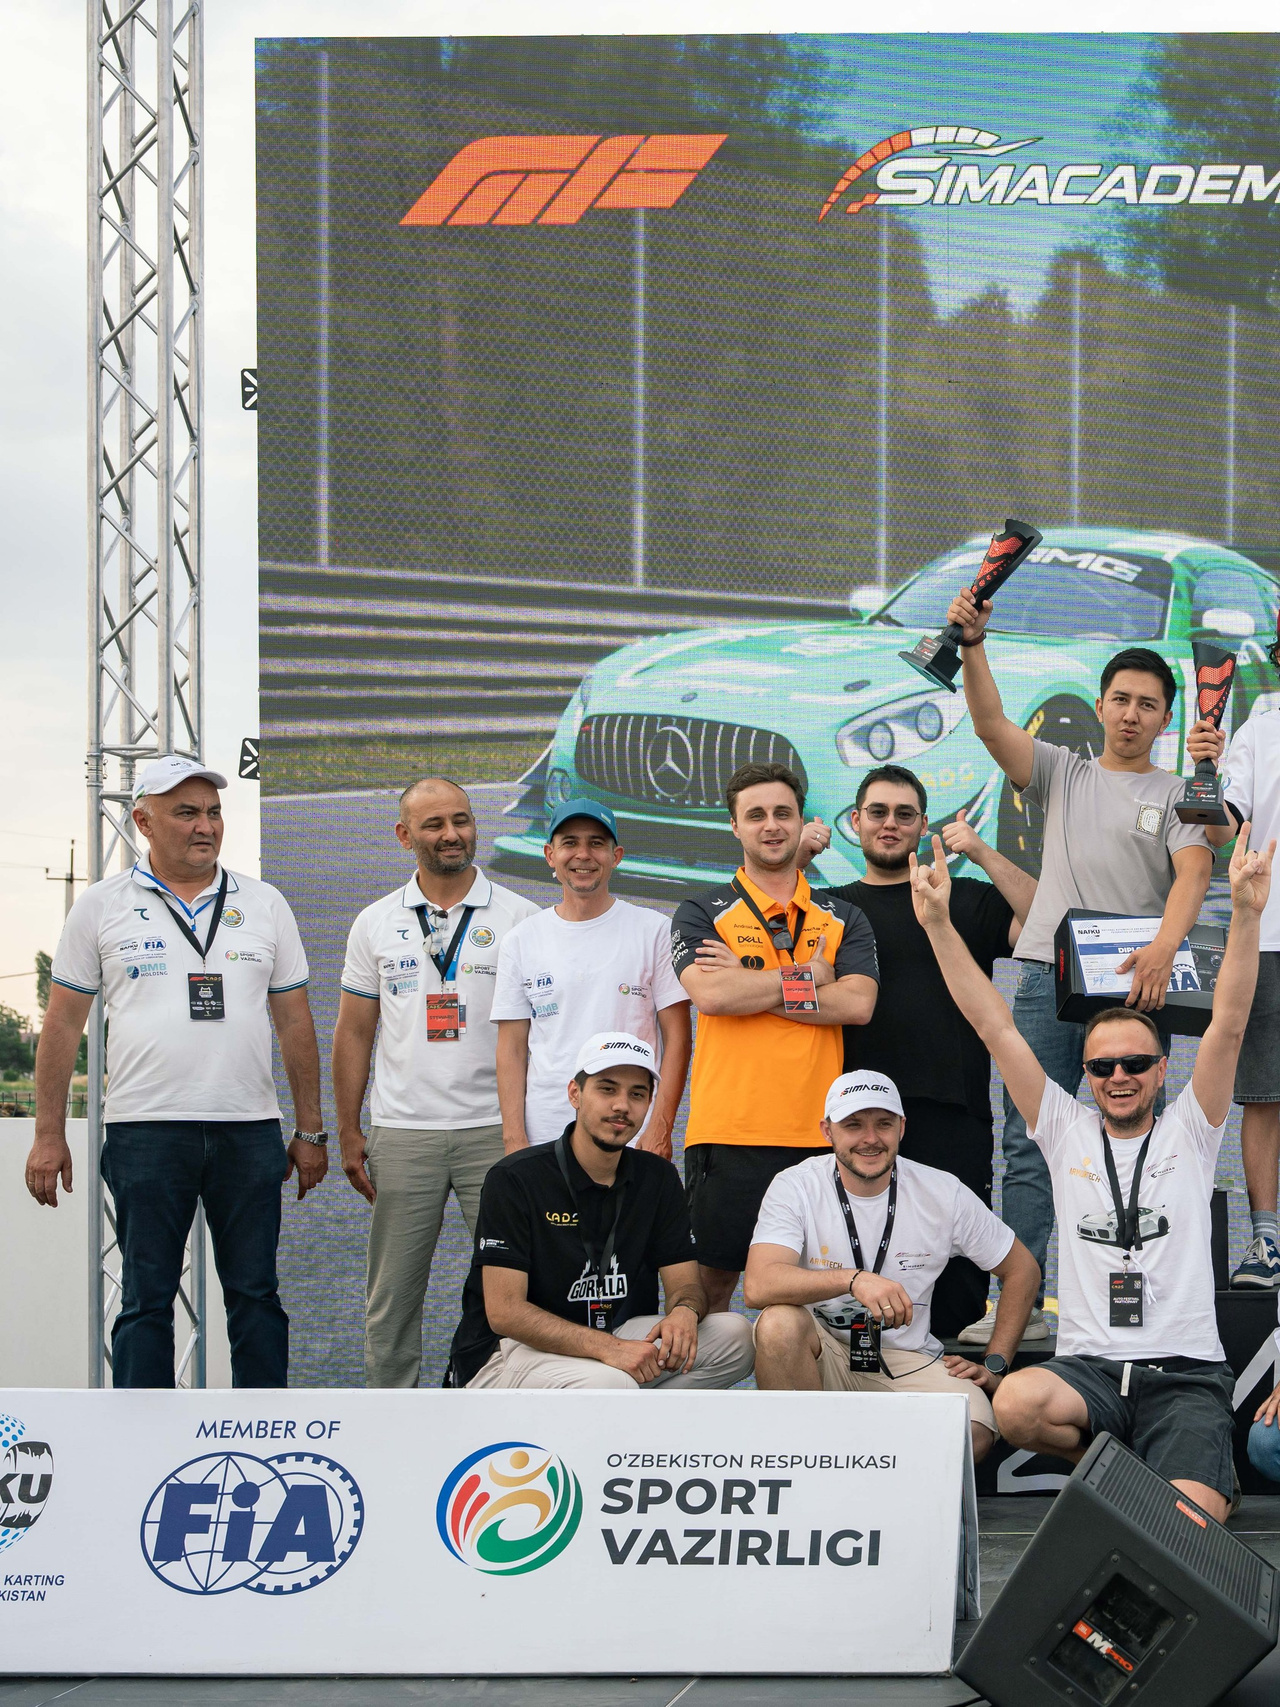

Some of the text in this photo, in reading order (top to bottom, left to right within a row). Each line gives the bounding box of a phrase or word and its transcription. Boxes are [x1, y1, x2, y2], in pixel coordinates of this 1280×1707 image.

[737, 935, 763, 944] DELL
[139, 962, 167, 972] BMB
[397, 980, 419, 990] BMB
[536, 1002, 559, 1014] BMB
[602, 1042, 650, 1057] SIMAGIC
[841, 1084, 890, 1096] SIMAGIC
[570, 1276, 626, 1300] GORLLA
[195, 1420, 341, 1440] MEMBER OF
[750, 1454, 897, 1469] RESPUBLIKASI
[600, 1477, 793, 1515] SPORT
[600, 1529, 881, 1567] VAZIRLIGI
[3, 1574, 65, 1586] KARTING
